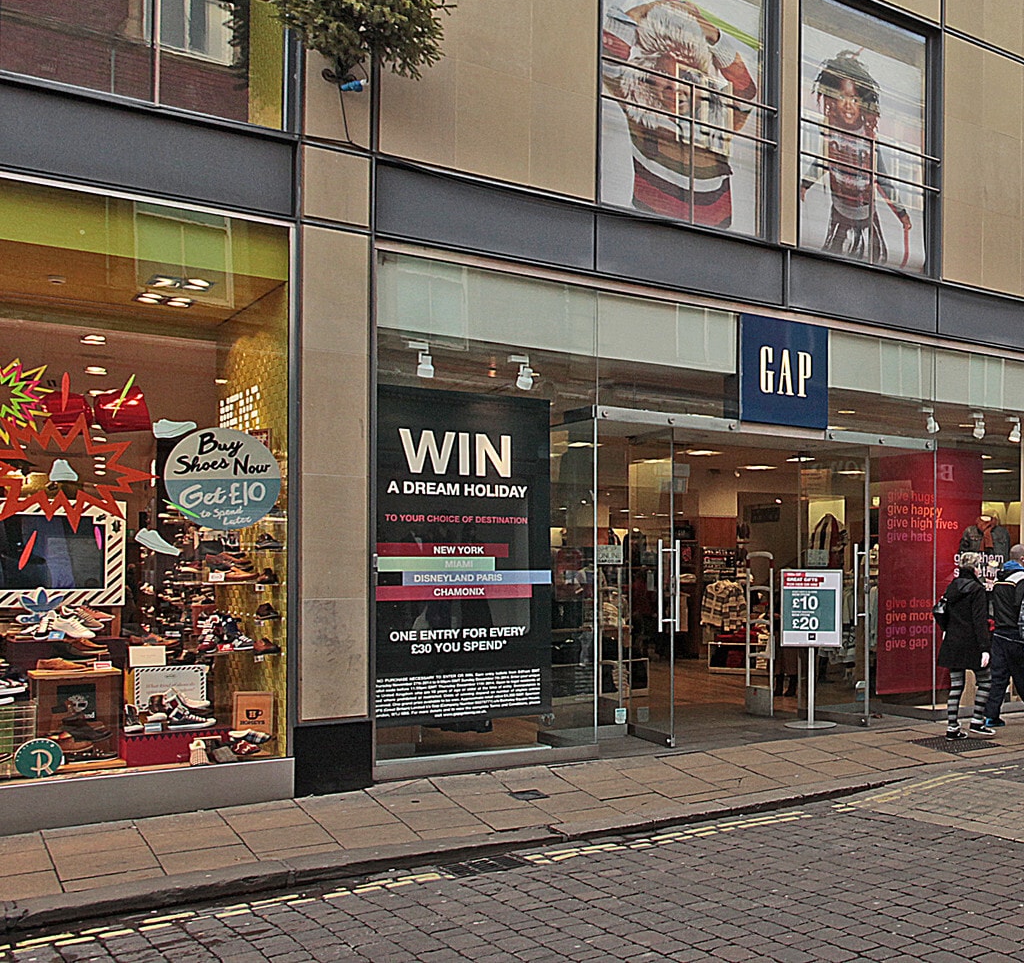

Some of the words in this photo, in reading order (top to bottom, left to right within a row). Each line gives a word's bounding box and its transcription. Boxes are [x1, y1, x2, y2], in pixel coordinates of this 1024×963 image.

[758, 345, 813, 398] GAP
[198, 432, 243, 458] Buy
[398, 428, 512, 478] WIN
[173, 455, 230, 475] Shoes
[232, 454, 271, 476] Now
[178, 483, 226, 509] Get
[228, 481, 267, 506] £10
[387, 480, 400, 495] A
[403, 481, 460, 497] DREAM
[464, 484, 528, 499] HOLIDAY
[887, 504, 909, 516] give
[911, 503, 943, 519] happy
[385, 513, 398, 522] TO
[400, 513, 425, 523] YOUR
[427, 514, 460, 524] CHOICE
[462, 515, 474, 524] OF
[475, 515, 528, 525] DESTINATION
[887, 517, 909, 529] give
[911, 517, 932, 531] high
[935, 517, 959, 530] fives
[887, 530, 909, 543] give
[910, 530, 932, 543] hats
[433, 545, 456, 555] NEW
[457, 545, 484, 555] YORK
[445, 559, 474, 569] MIAMI
[414, 574, 475, 583] DISNEYLAND
[476, 573, 503, 582] PARIS
[433, 587, 485, 597] CHAMONIX
[792, 595, 819, 611] £10
[886, 598, 907, 610] give
[792, 616, 819, 631] £20
[886, 611, 907, 624] give
[909, 612, 934, 622] more
[389, 630, 417, 642] ONE
[419, 629, 460, 641] ENTRY
[462, 628, 487, 639] FOR
[489, 625, 526, 637] EVERY
[886, 625, 907, 637] give
[411, 642, 432, 655] £30
[434, 641, 461, 653] YOU
[886, 638, 907, 651] give
[909, 638, 928, 651] gap
